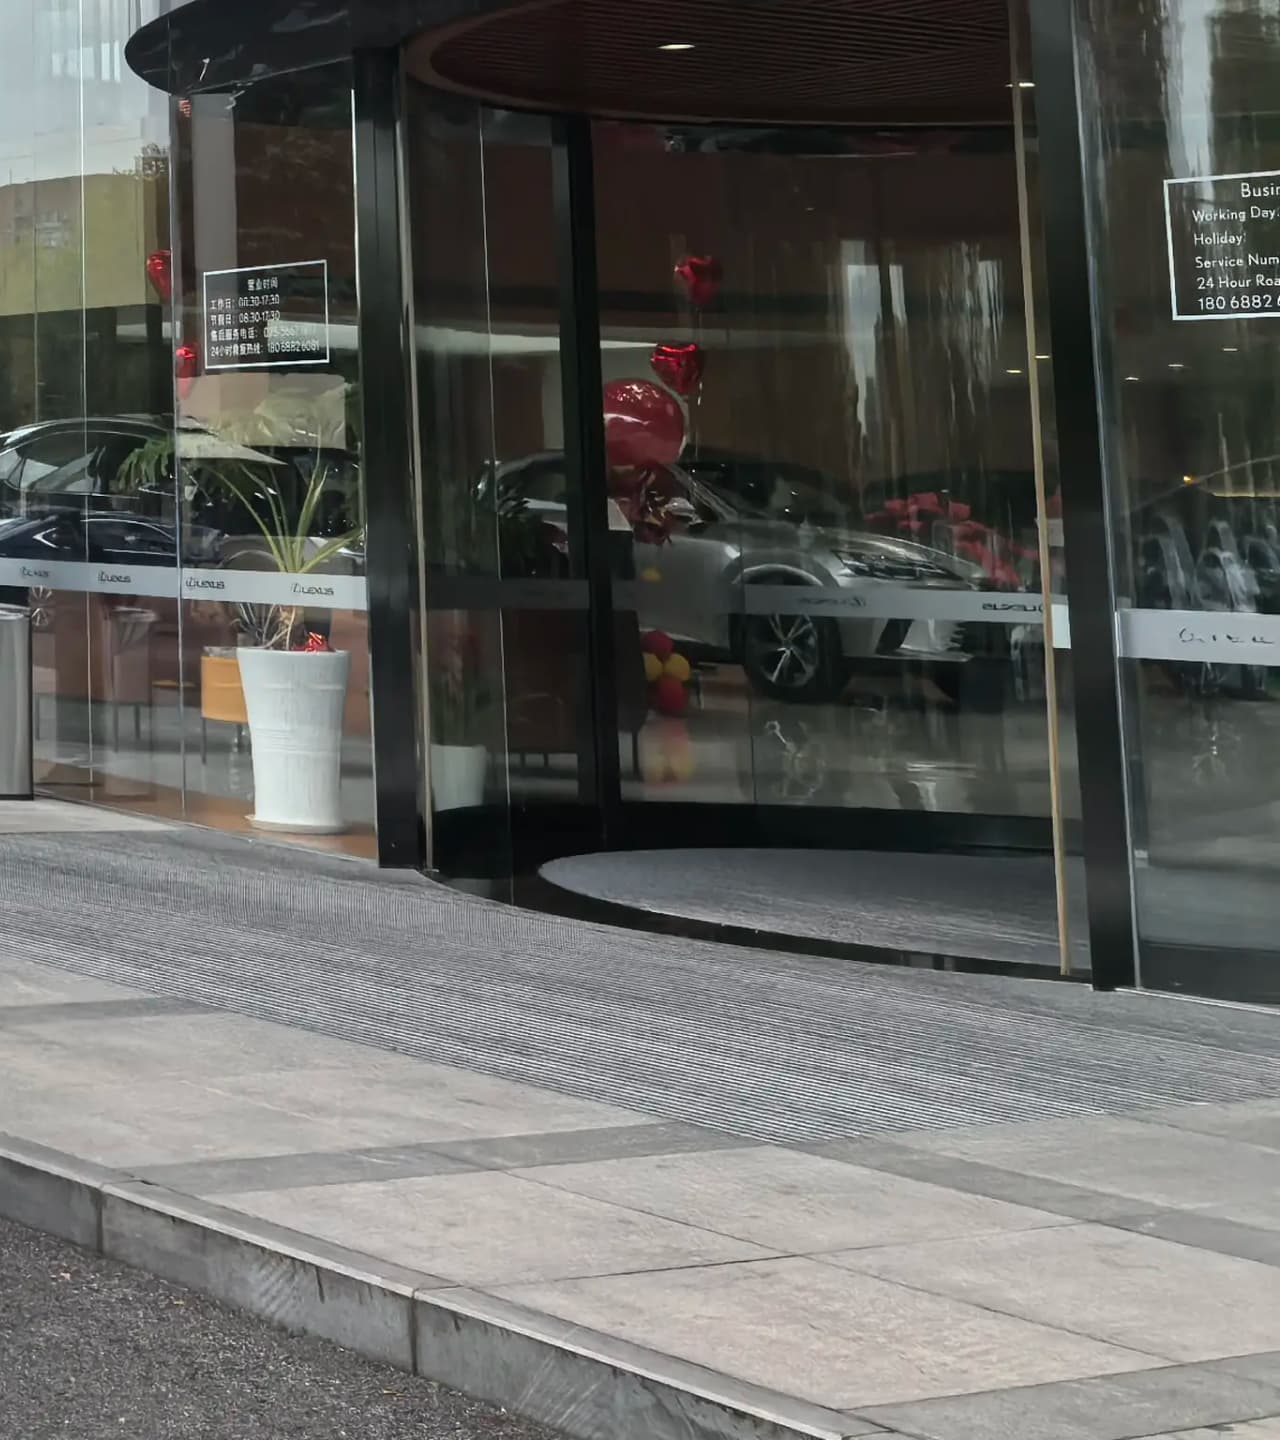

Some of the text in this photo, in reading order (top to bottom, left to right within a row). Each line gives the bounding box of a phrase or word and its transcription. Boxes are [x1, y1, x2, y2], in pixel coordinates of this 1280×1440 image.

[1192, 205, 1280, 222] Working Day:
[1193, 231, 1247, 246] Holiday:
[1195, 255, 1244, 269] Service
[247, 277, 279, 291] 营业时间
[1196, 277, 1214, 289] 24
[1218, 274, 1252, 288] Hour
[1198, 296, 1226, 311] 180
[1230, 294, 1272, 310] 6882
